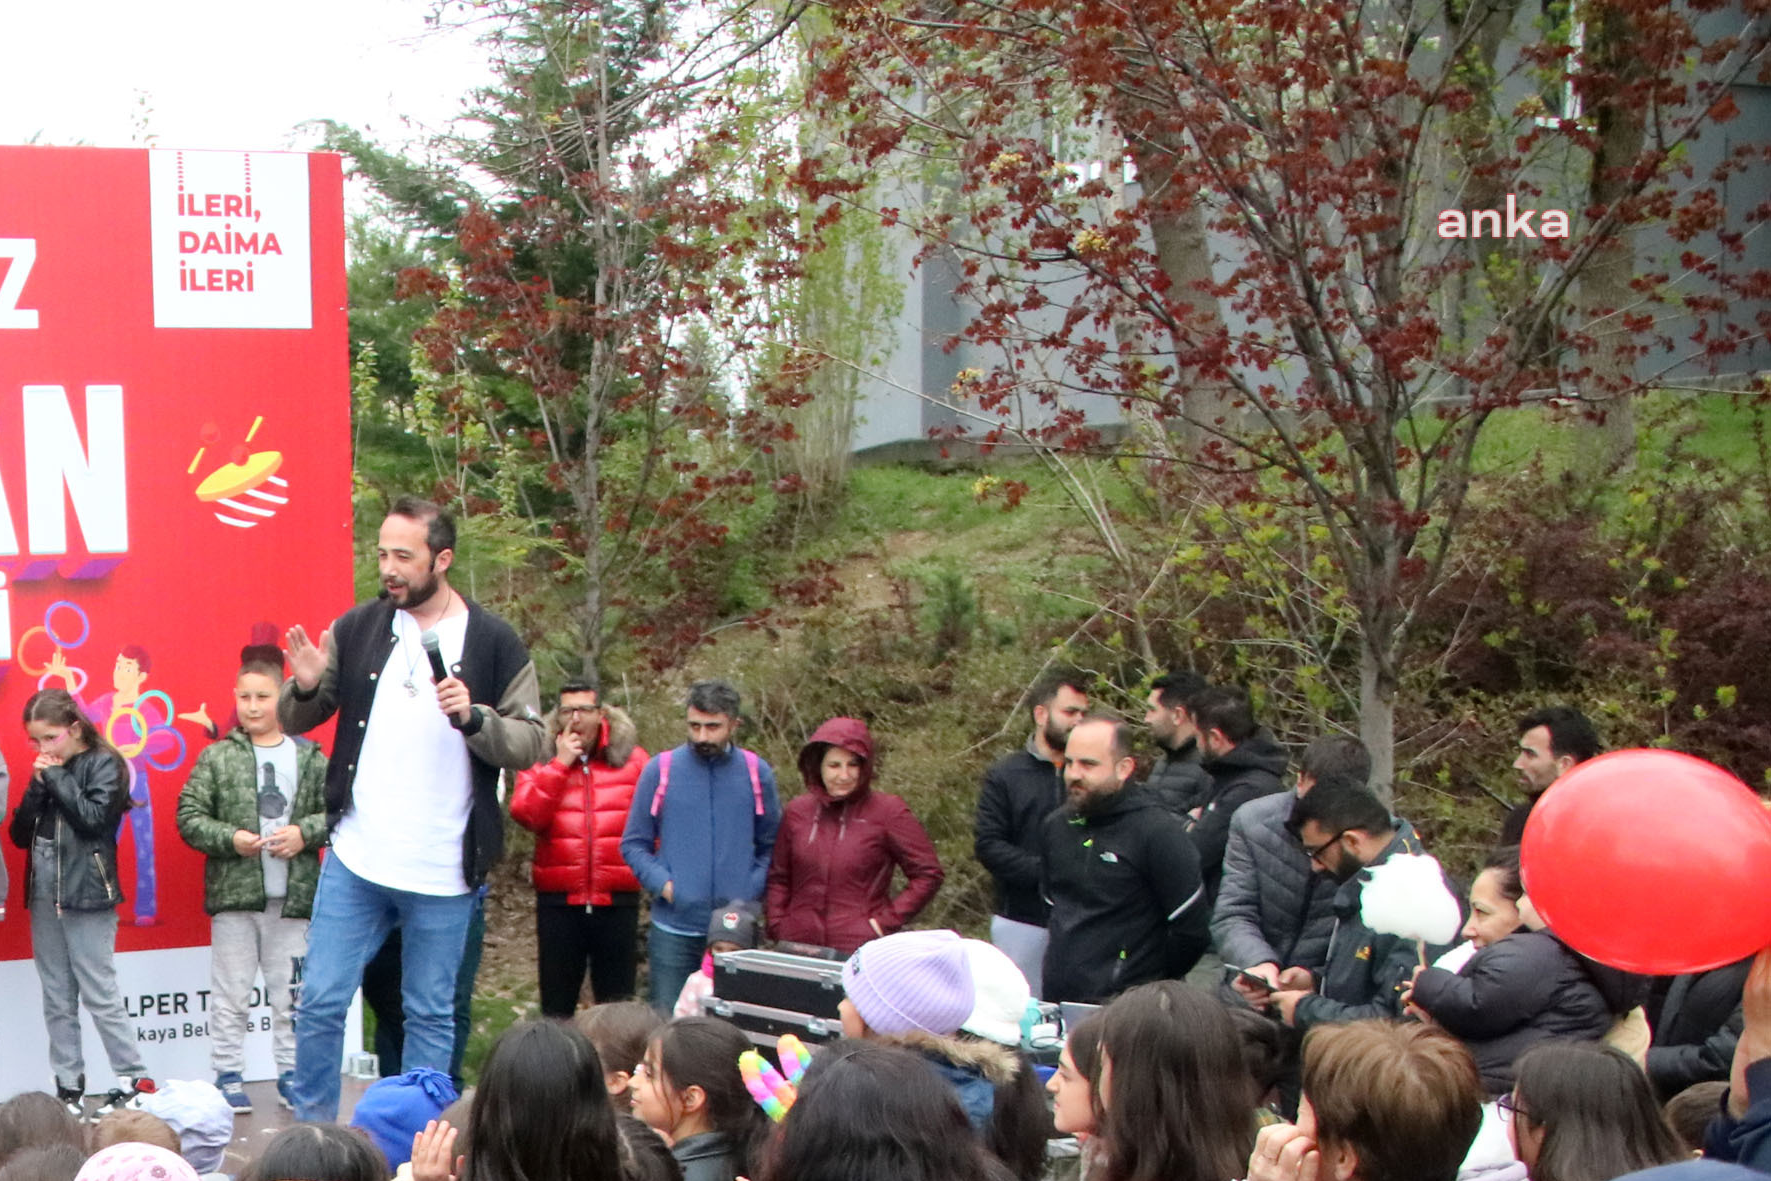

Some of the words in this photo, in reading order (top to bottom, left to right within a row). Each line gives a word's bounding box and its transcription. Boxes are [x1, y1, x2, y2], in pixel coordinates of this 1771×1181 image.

[178, 185, 261, 223] İLERİ,
[179, 222, 283, 256] DAİMA
[180, 259, 255, 292] İLERİ
[124, 991, 189, 1019] LPER
[137, 1023, 178, 1045] kaya
